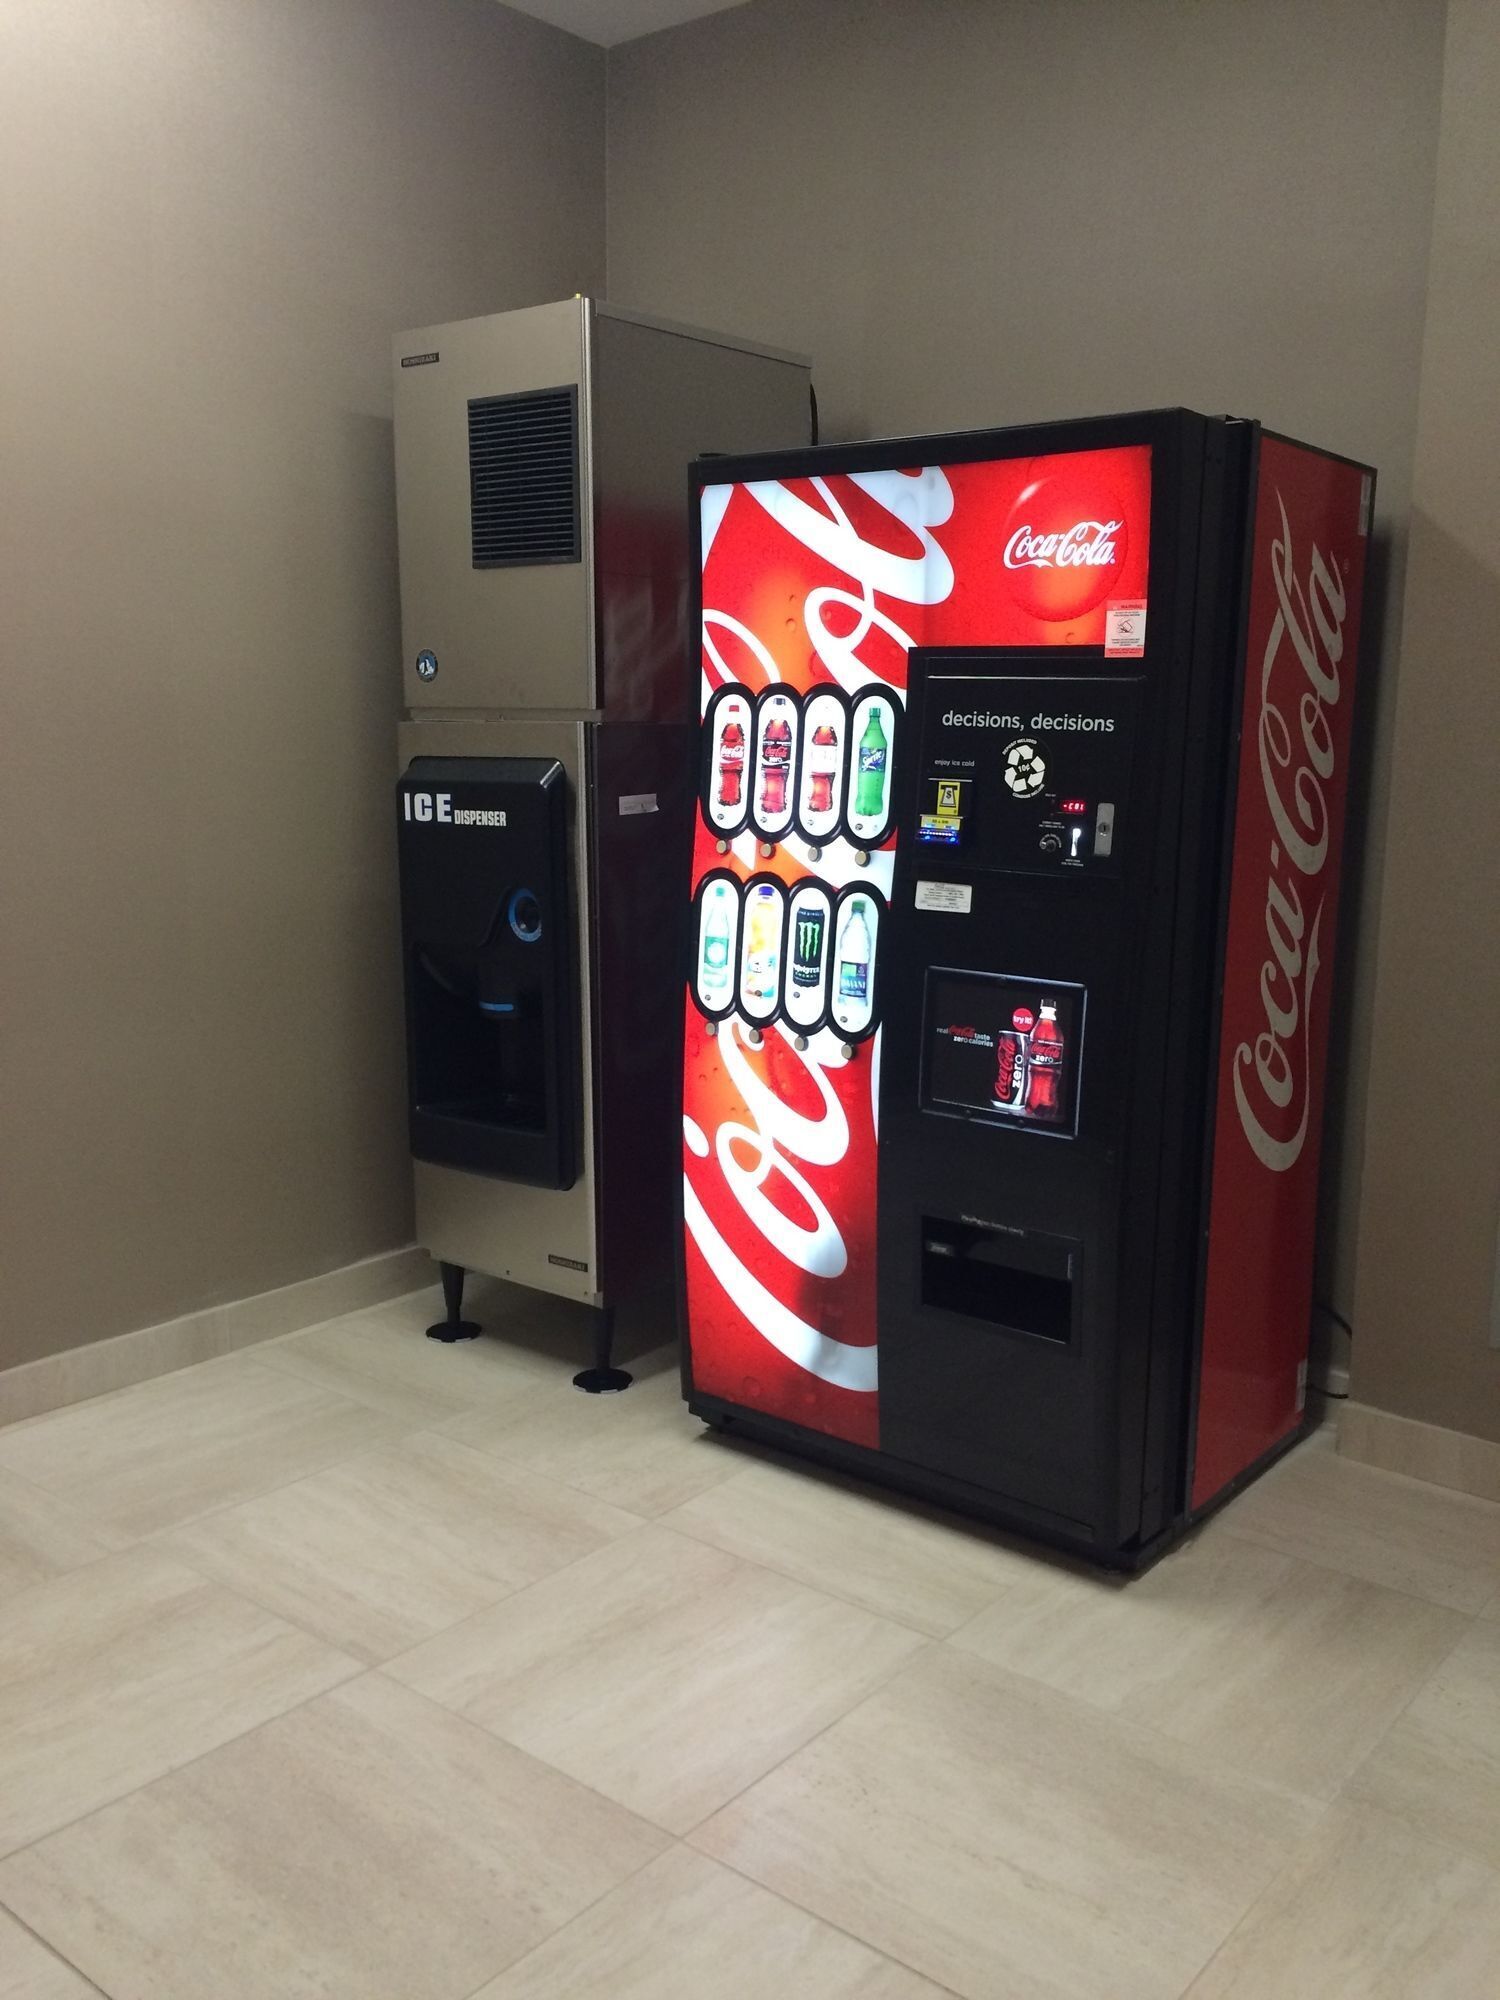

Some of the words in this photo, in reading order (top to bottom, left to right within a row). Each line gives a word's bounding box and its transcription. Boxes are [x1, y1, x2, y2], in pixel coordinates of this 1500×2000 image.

[1003, 519, 1124, 569] Coca-Cola
[942, 710, 1025, 732] decisions,
[1030, 713, 1115, 732] decisions
[403, 792, 452, 823] ICE
[454, 809, 507, 827] DISPENSER
[1232, 486, 1346, 1172] Coca-Cola
[1013, 1015, 1024, 1024] try
[974, 1033, 991, 1041] taste
[1012, 1054, 1024, 1088] zero
[1035, 1055, 1054, 1063] zero
